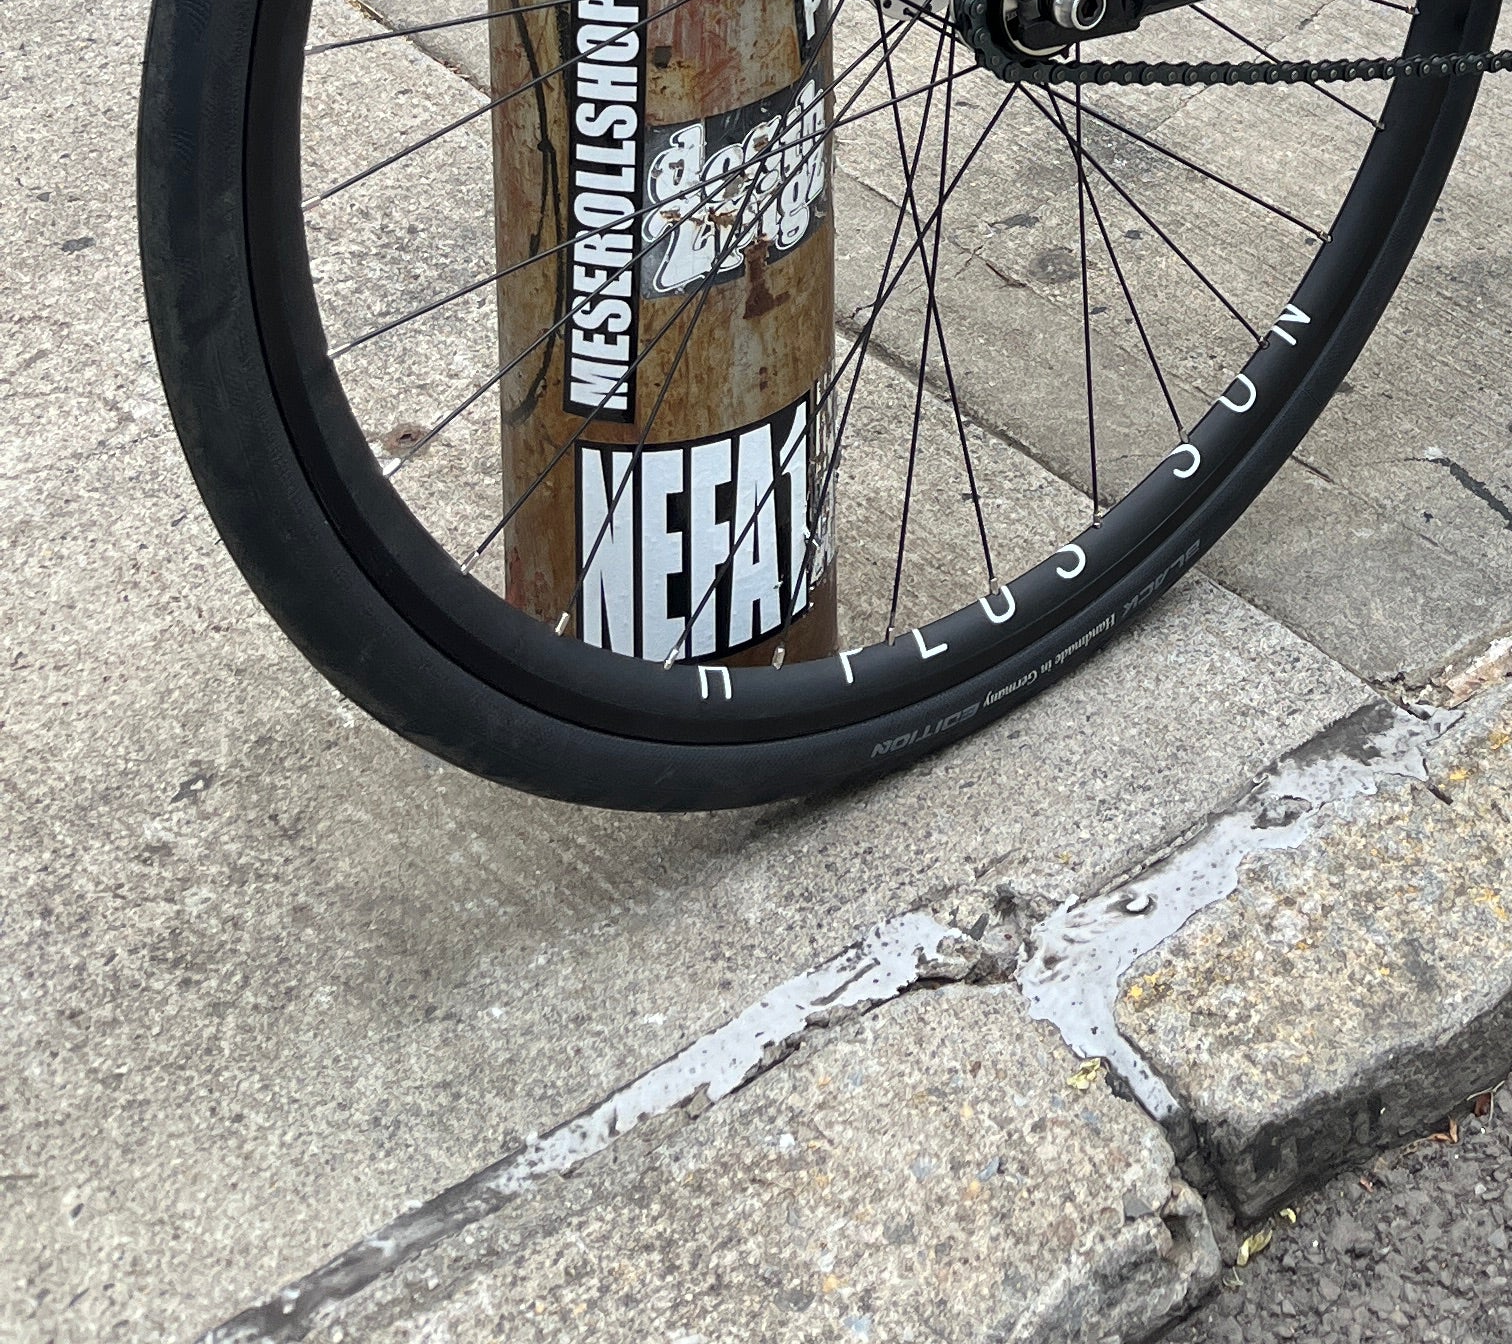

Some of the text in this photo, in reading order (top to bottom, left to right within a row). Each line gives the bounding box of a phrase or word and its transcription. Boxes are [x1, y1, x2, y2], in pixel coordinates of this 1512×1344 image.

[1169, 302, 1313, 480] SON
[1054, 611, 1119, 668] Handmade
[981, 664, 1042, 711] Germany
[871, 703, 981, 760] EDITION
